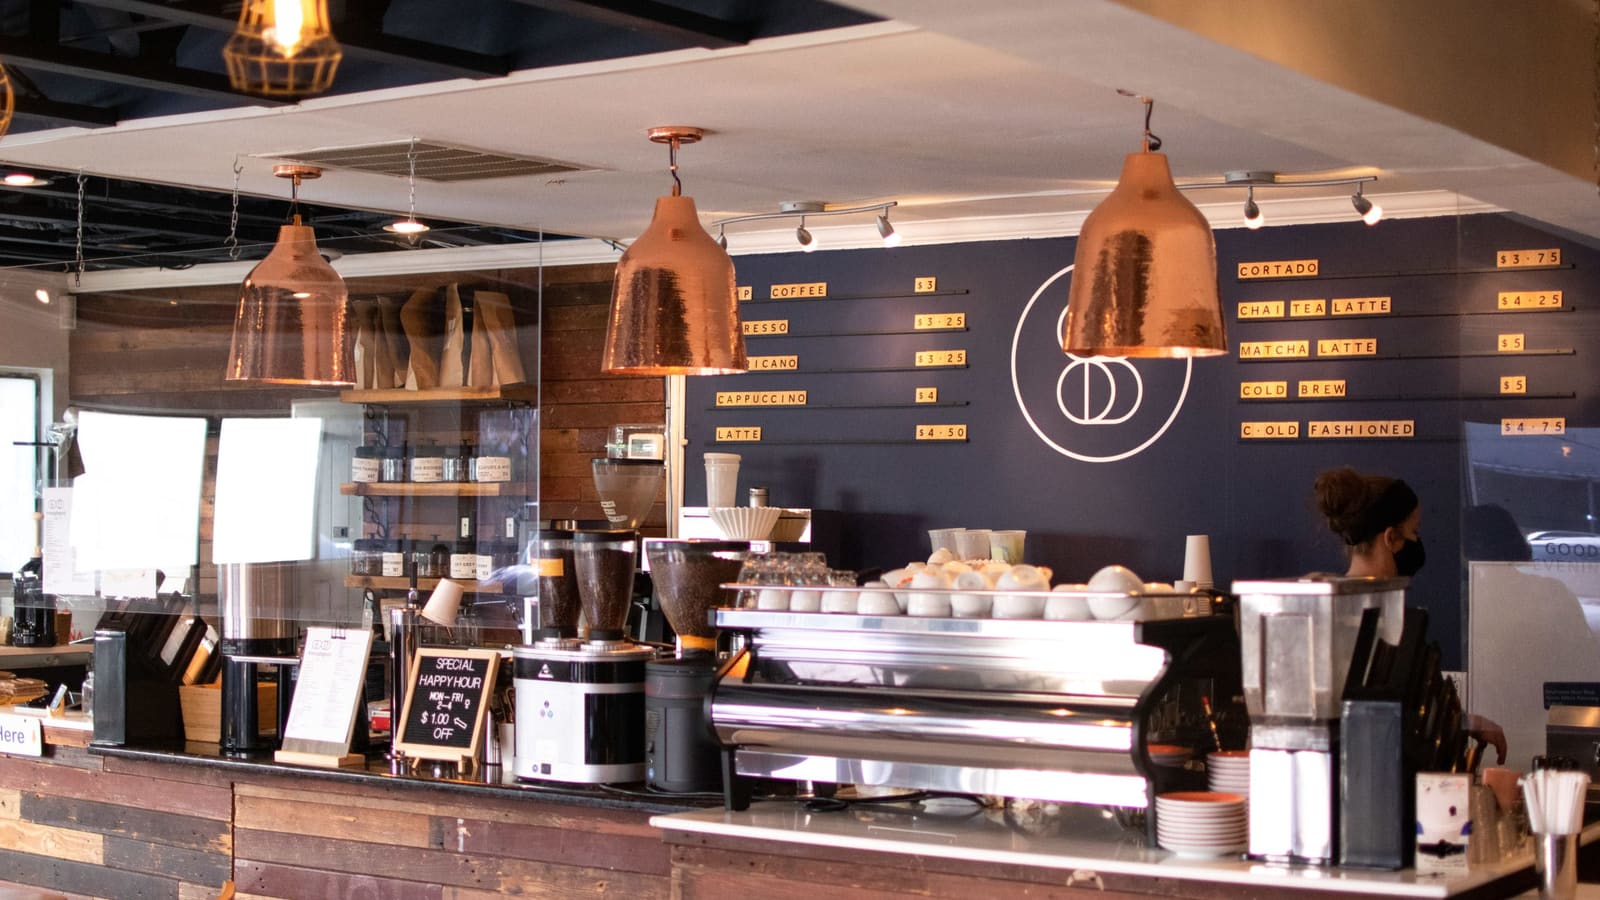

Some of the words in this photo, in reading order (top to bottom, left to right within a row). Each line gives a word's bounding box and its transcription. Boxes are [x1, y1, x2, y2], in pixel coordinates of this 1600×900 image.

[1240, 263, 1317, 276] CORTADO
[771, 285, 825, 297] COFFEE
[917, 280, 933, 290] $3
[1240, 304, 1280, 315] CHAI
[1293, 303, 1324, 314] TEA
[1334, 300, 1388, 312] LATTE
[744, 323, 787, 333] RESSO
[1241, 344, 1306, 355] MATCHA
[1320, 342, 1373, 353] LATTE
[1501, 338, 1521, 348] $5
[1242, 385, 1285, 396] COLD
[1301, 384, 1345, 395] BREW
[1503, 380, 1523, 391] $5
[717, 394, 806, 405] CAPPUCCINO
[918, 391, 934, 400] $4
[718, 430, 759, 439] LATTE
[1311, 424, 1413, 435] FASHIONED
[1545, 542, 1598, 557] GOOD
[436, 658, 475, 671] SPECIAL
[419, 675, 454, 687] HAPPY
[453, 676, 482, 689] HOUR
[433, 728, 454, 740] OFF
